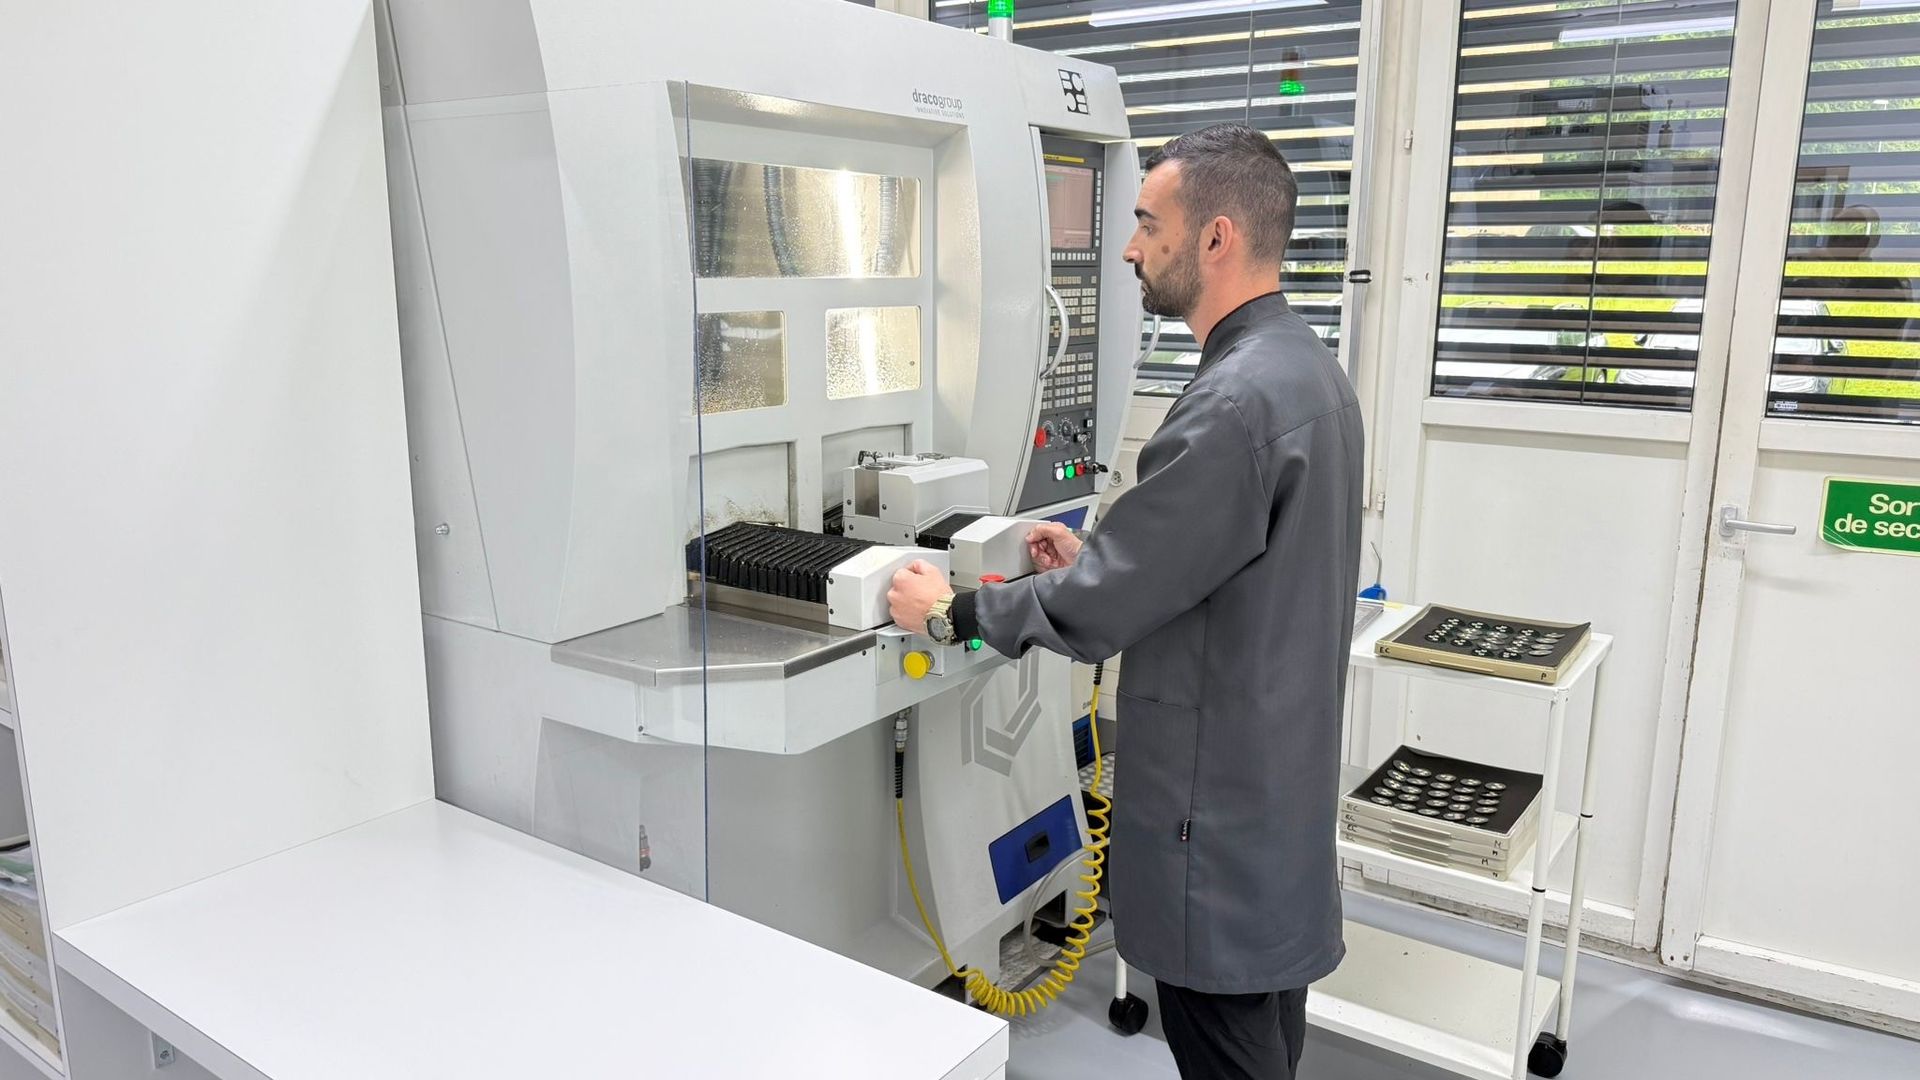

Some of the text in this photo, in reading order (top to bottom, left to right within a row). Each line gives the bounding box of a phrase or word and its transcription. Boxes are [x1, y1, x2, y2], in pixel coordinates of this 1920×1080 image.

[912, 88, 963, 110] dracogroup
[1834, 512, 1868, 534] de
[1379, 646, 1391, 654] EC
